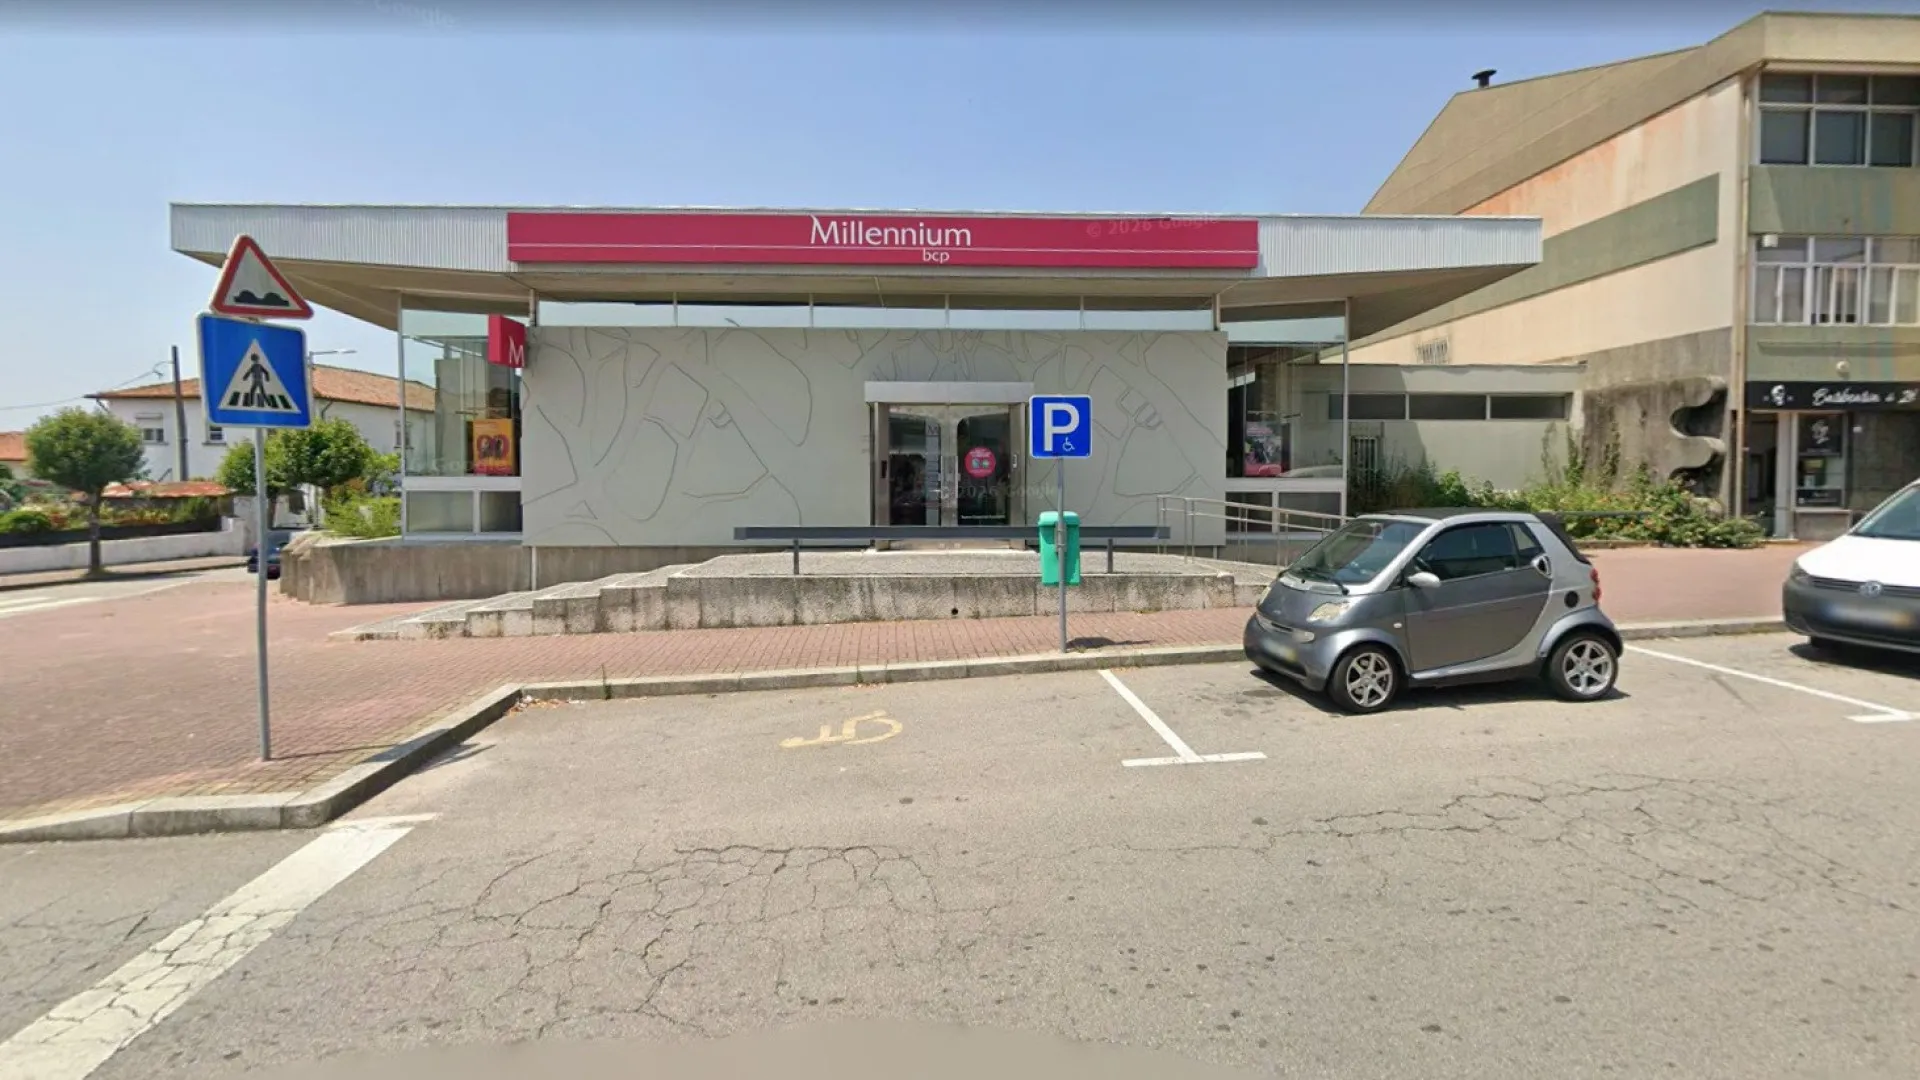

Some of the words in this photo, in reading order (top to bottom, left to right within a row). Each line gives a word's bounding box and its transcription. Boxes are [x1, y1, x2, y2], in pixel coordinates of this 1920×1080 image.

[809, 214, 972, 247] Millennium
[922, 247, 950, 264] bcp
[508, 335, 525, 368] M
[1043, 402, 1080, 452] P
